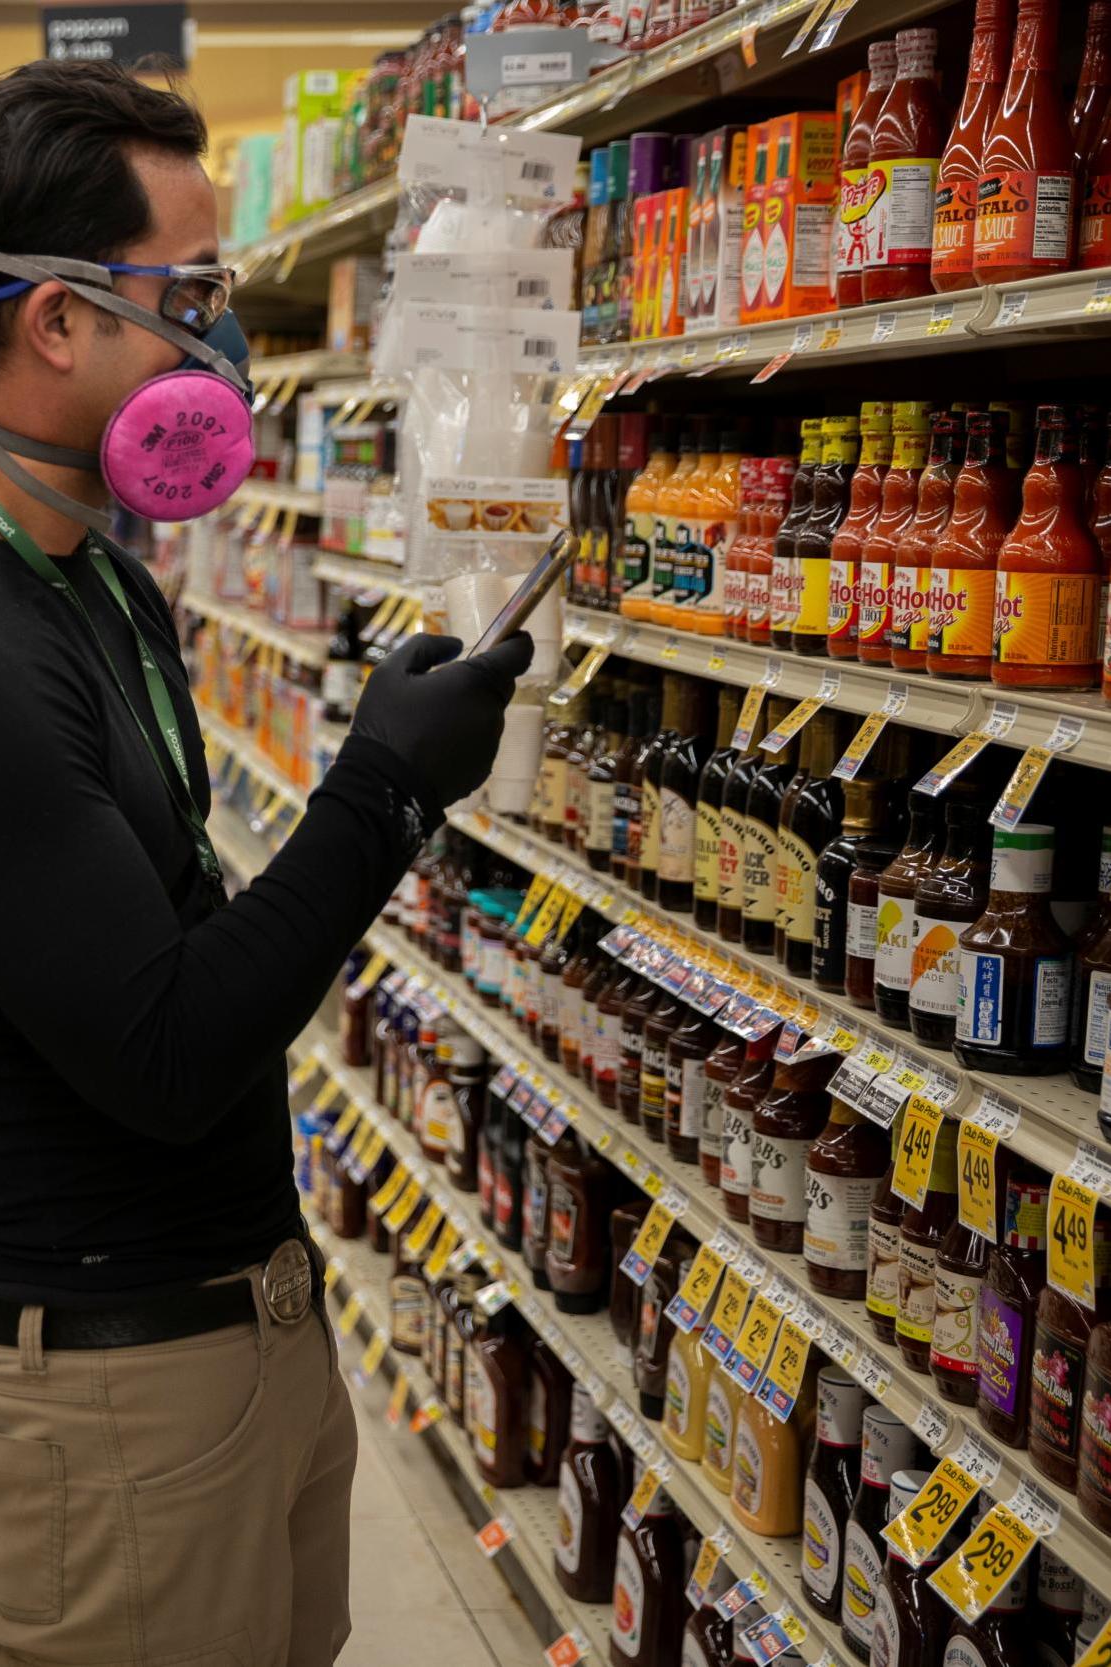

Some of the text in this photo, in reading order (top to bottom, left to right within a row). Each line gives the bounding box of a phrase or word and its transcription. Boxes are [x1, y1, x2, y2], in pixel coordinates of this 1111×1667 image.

[49, 17, 129, 40] popcorn
[939, 224, 967, 247] SAUCE
[985, 216, 1017, 240] SAUCE
[177, 411, 226, 437] 2097
[141, 423, 167, 453] 3M
[143, 475, 192, 500] 2097
[199, 462, 226, 490] 3M
[925, 948, 954, 958] GINGER
[913, 1100, 939, 1120] Club Price!
[903, 1120, 931, 1164] 449
[964, 1125, 995, 1146] Club Price!
[963, 1149, 990, 1195] 449
[1057, 1179, 1093, 1206] Club Price!
[1053, 1205, 1087, 1255] 449
[943, 1463, 976, 1492] Club Price!
[911, 1482, 959, 1525] 299
[995, 1510, 1032, 1544] Club Price!
[963, 1530, 1015, 1578] 299
[1049, 1579, 1076, 1590] Boss!
